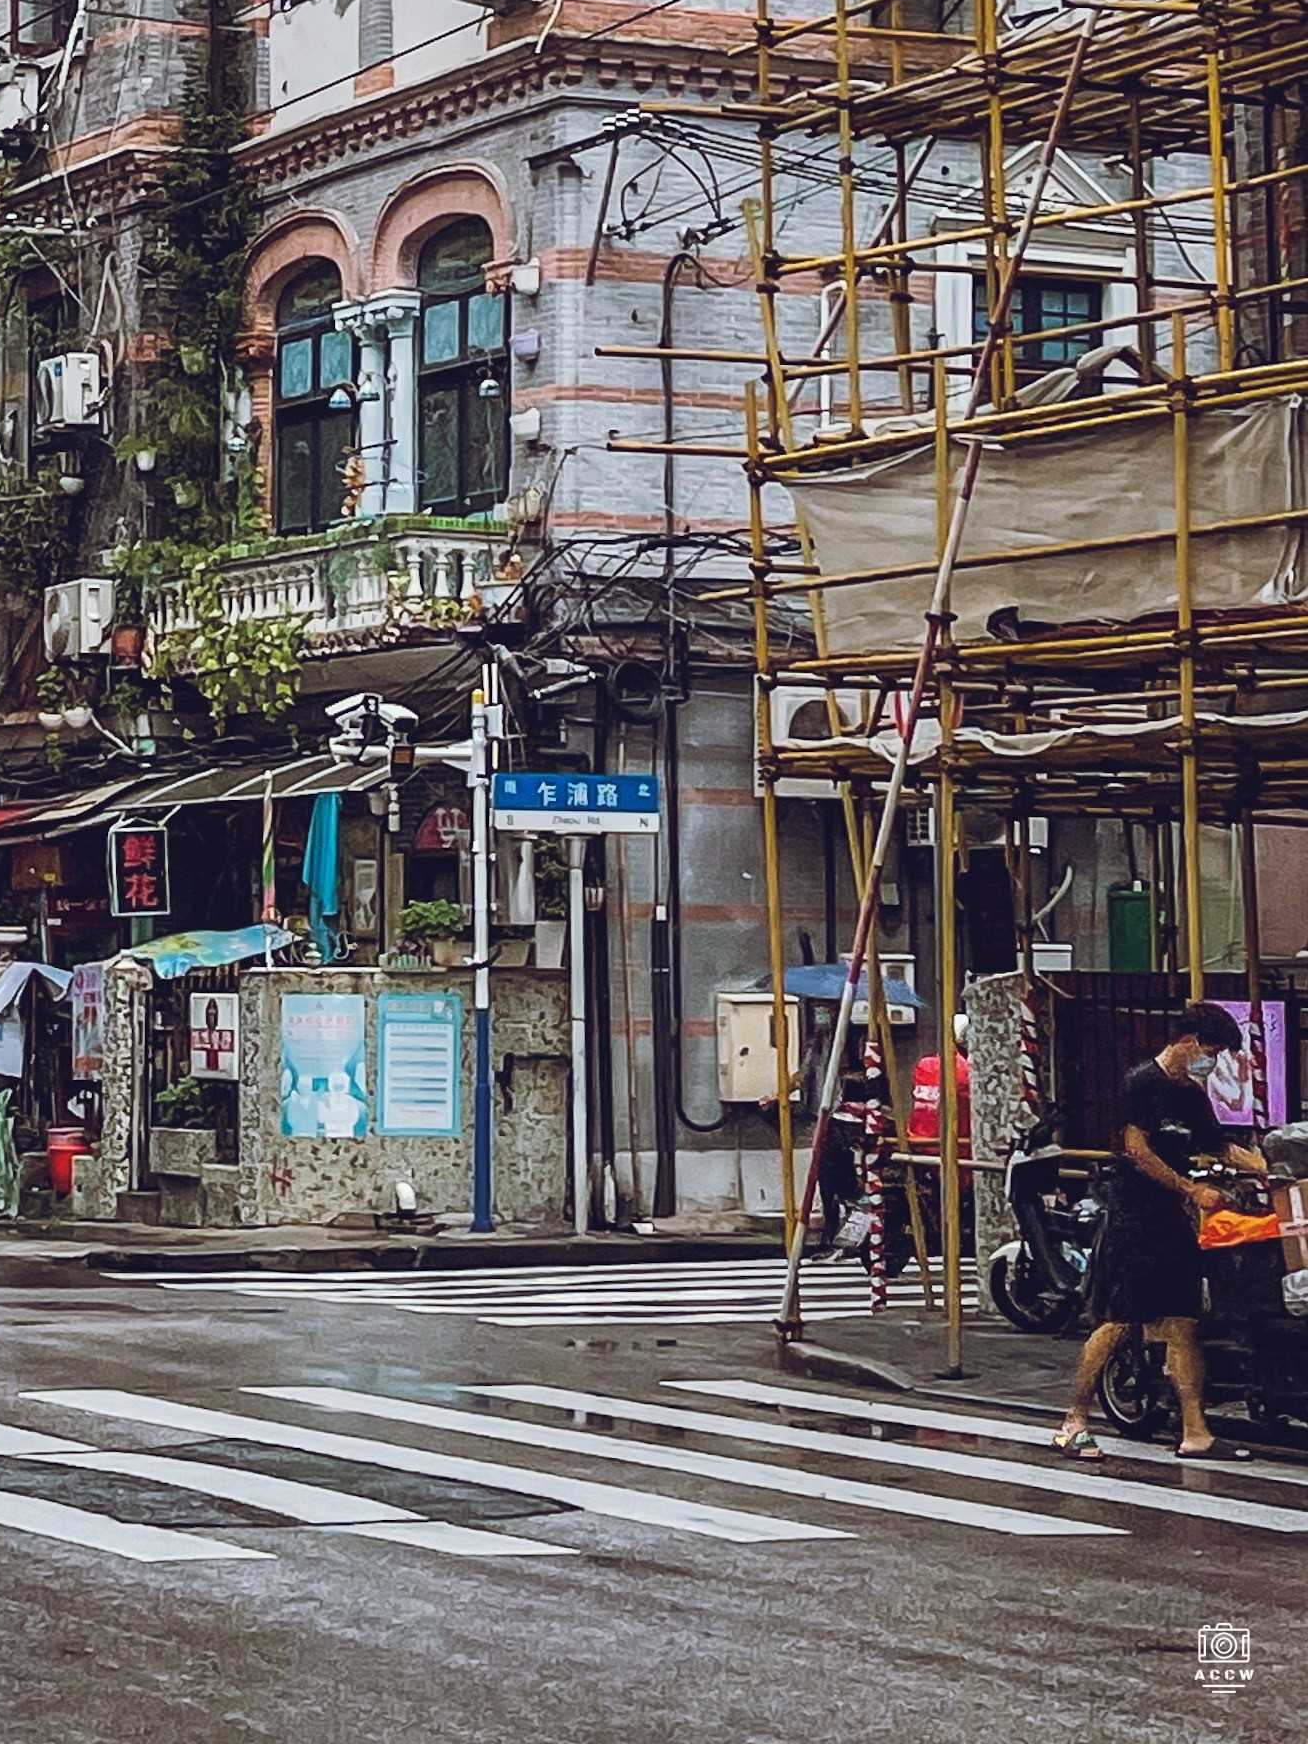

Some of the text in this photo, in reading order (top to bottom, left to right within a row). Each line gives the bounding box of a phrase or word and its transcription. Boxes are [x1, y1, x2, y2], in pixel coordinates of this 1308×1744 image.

[537, 781, 618, 807] 乍浦路
[123, 835, 158, 909] 鲜花
